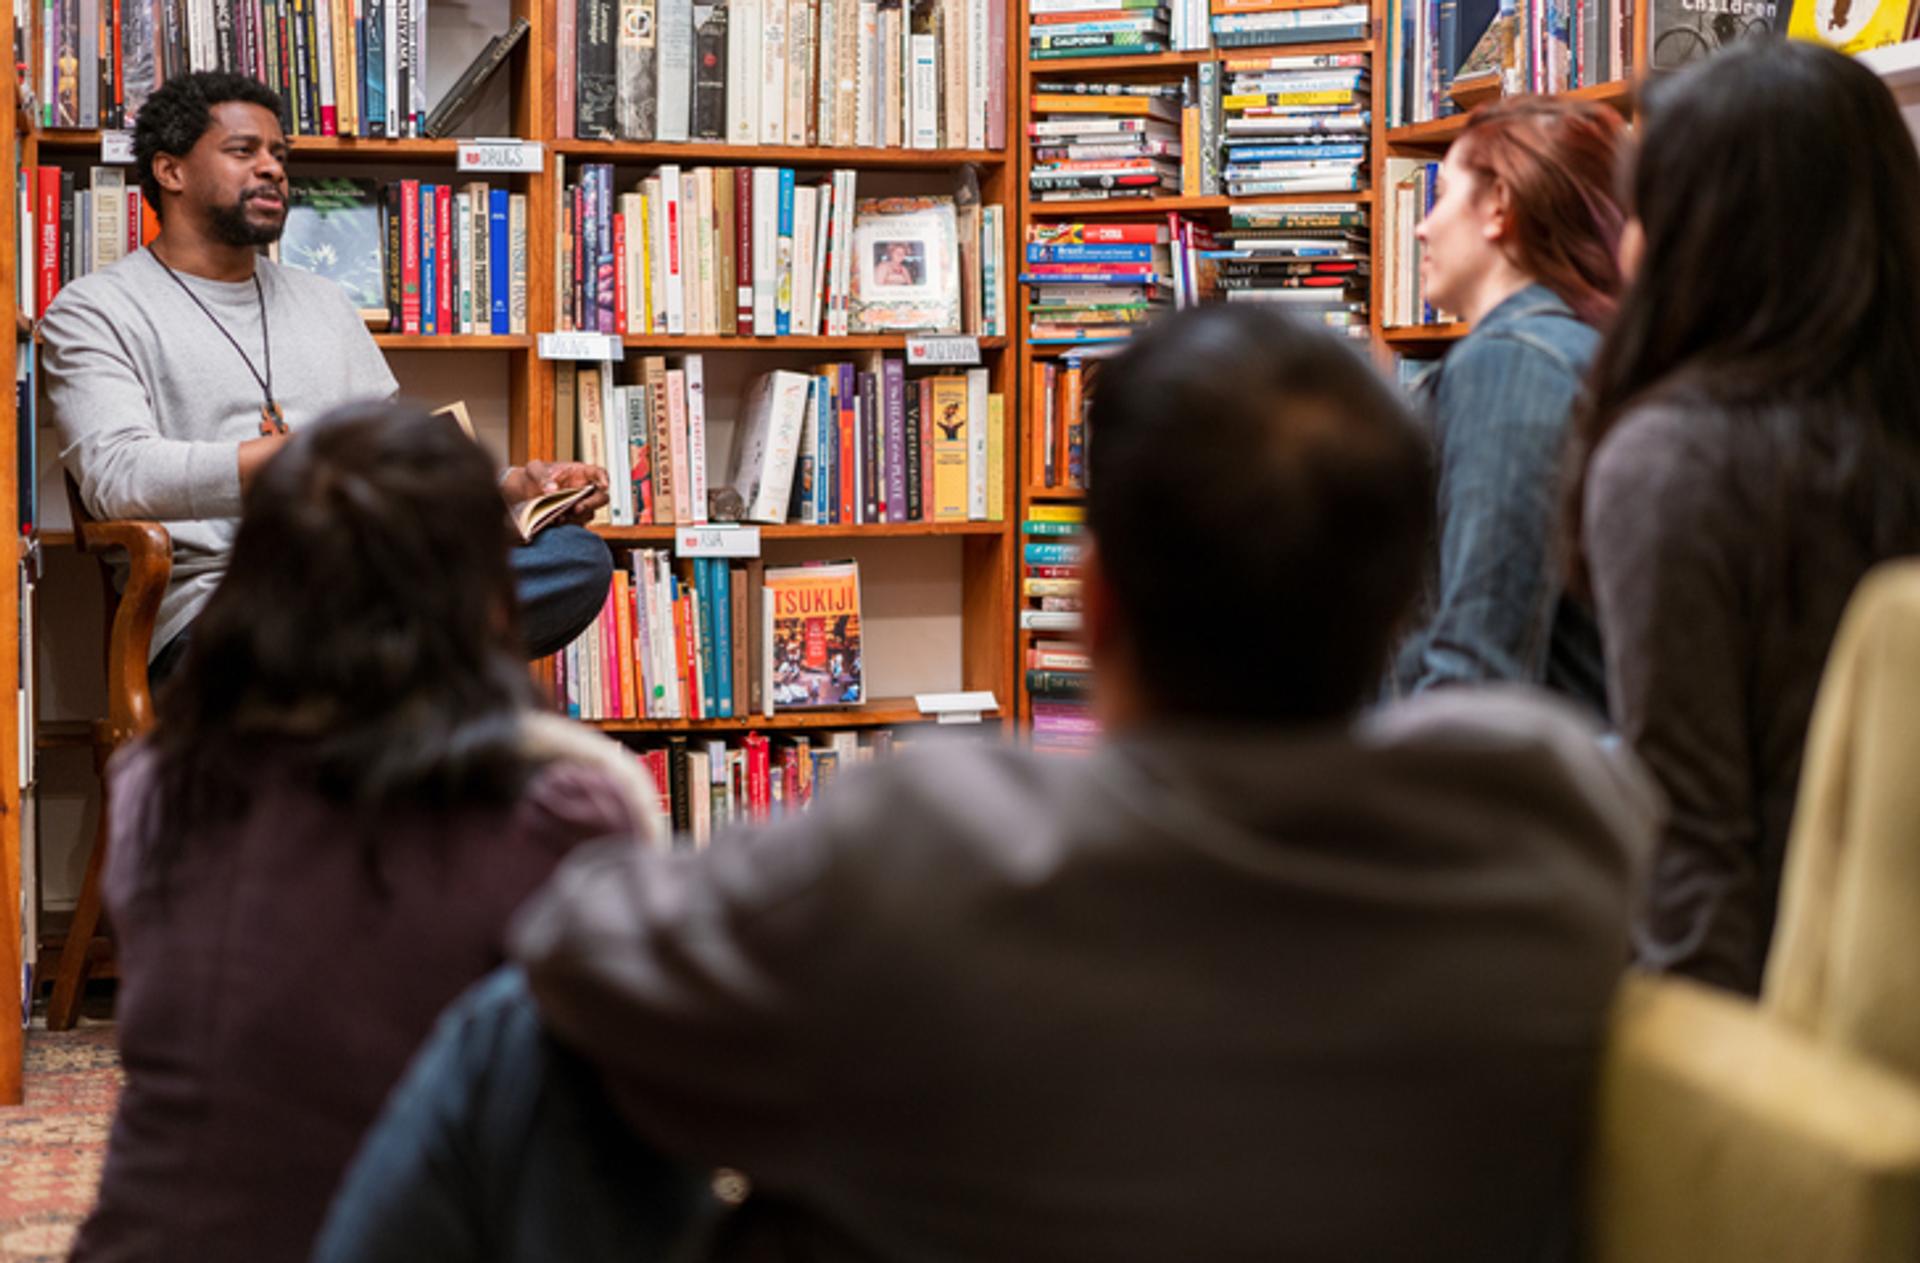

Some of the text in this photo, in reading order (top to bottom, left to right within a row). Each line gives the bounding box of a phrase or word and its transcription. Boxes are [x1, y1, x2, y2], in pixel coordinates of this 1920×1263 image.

[1681, 0, 1776, 17] Children
[1053, 35, 1106, 47] CALIFORNIA
[481, 147, 524, 167] DRUGS
[44, 223, 57, 270] HOSPITAL
[629, 397, 643, 436] COOKIES
[655, 382, 667, 436] BREAD
[891, 400, 902, 441] HEART
[694, 414, 703, 461] PERFECT
[907, 408, 919, 507] Vegetarianism
[659, 445, 671, 496] ALONE
[892, 464, 902, 499] PLATE
[774, 588, 853, 613] TSUKIJI
